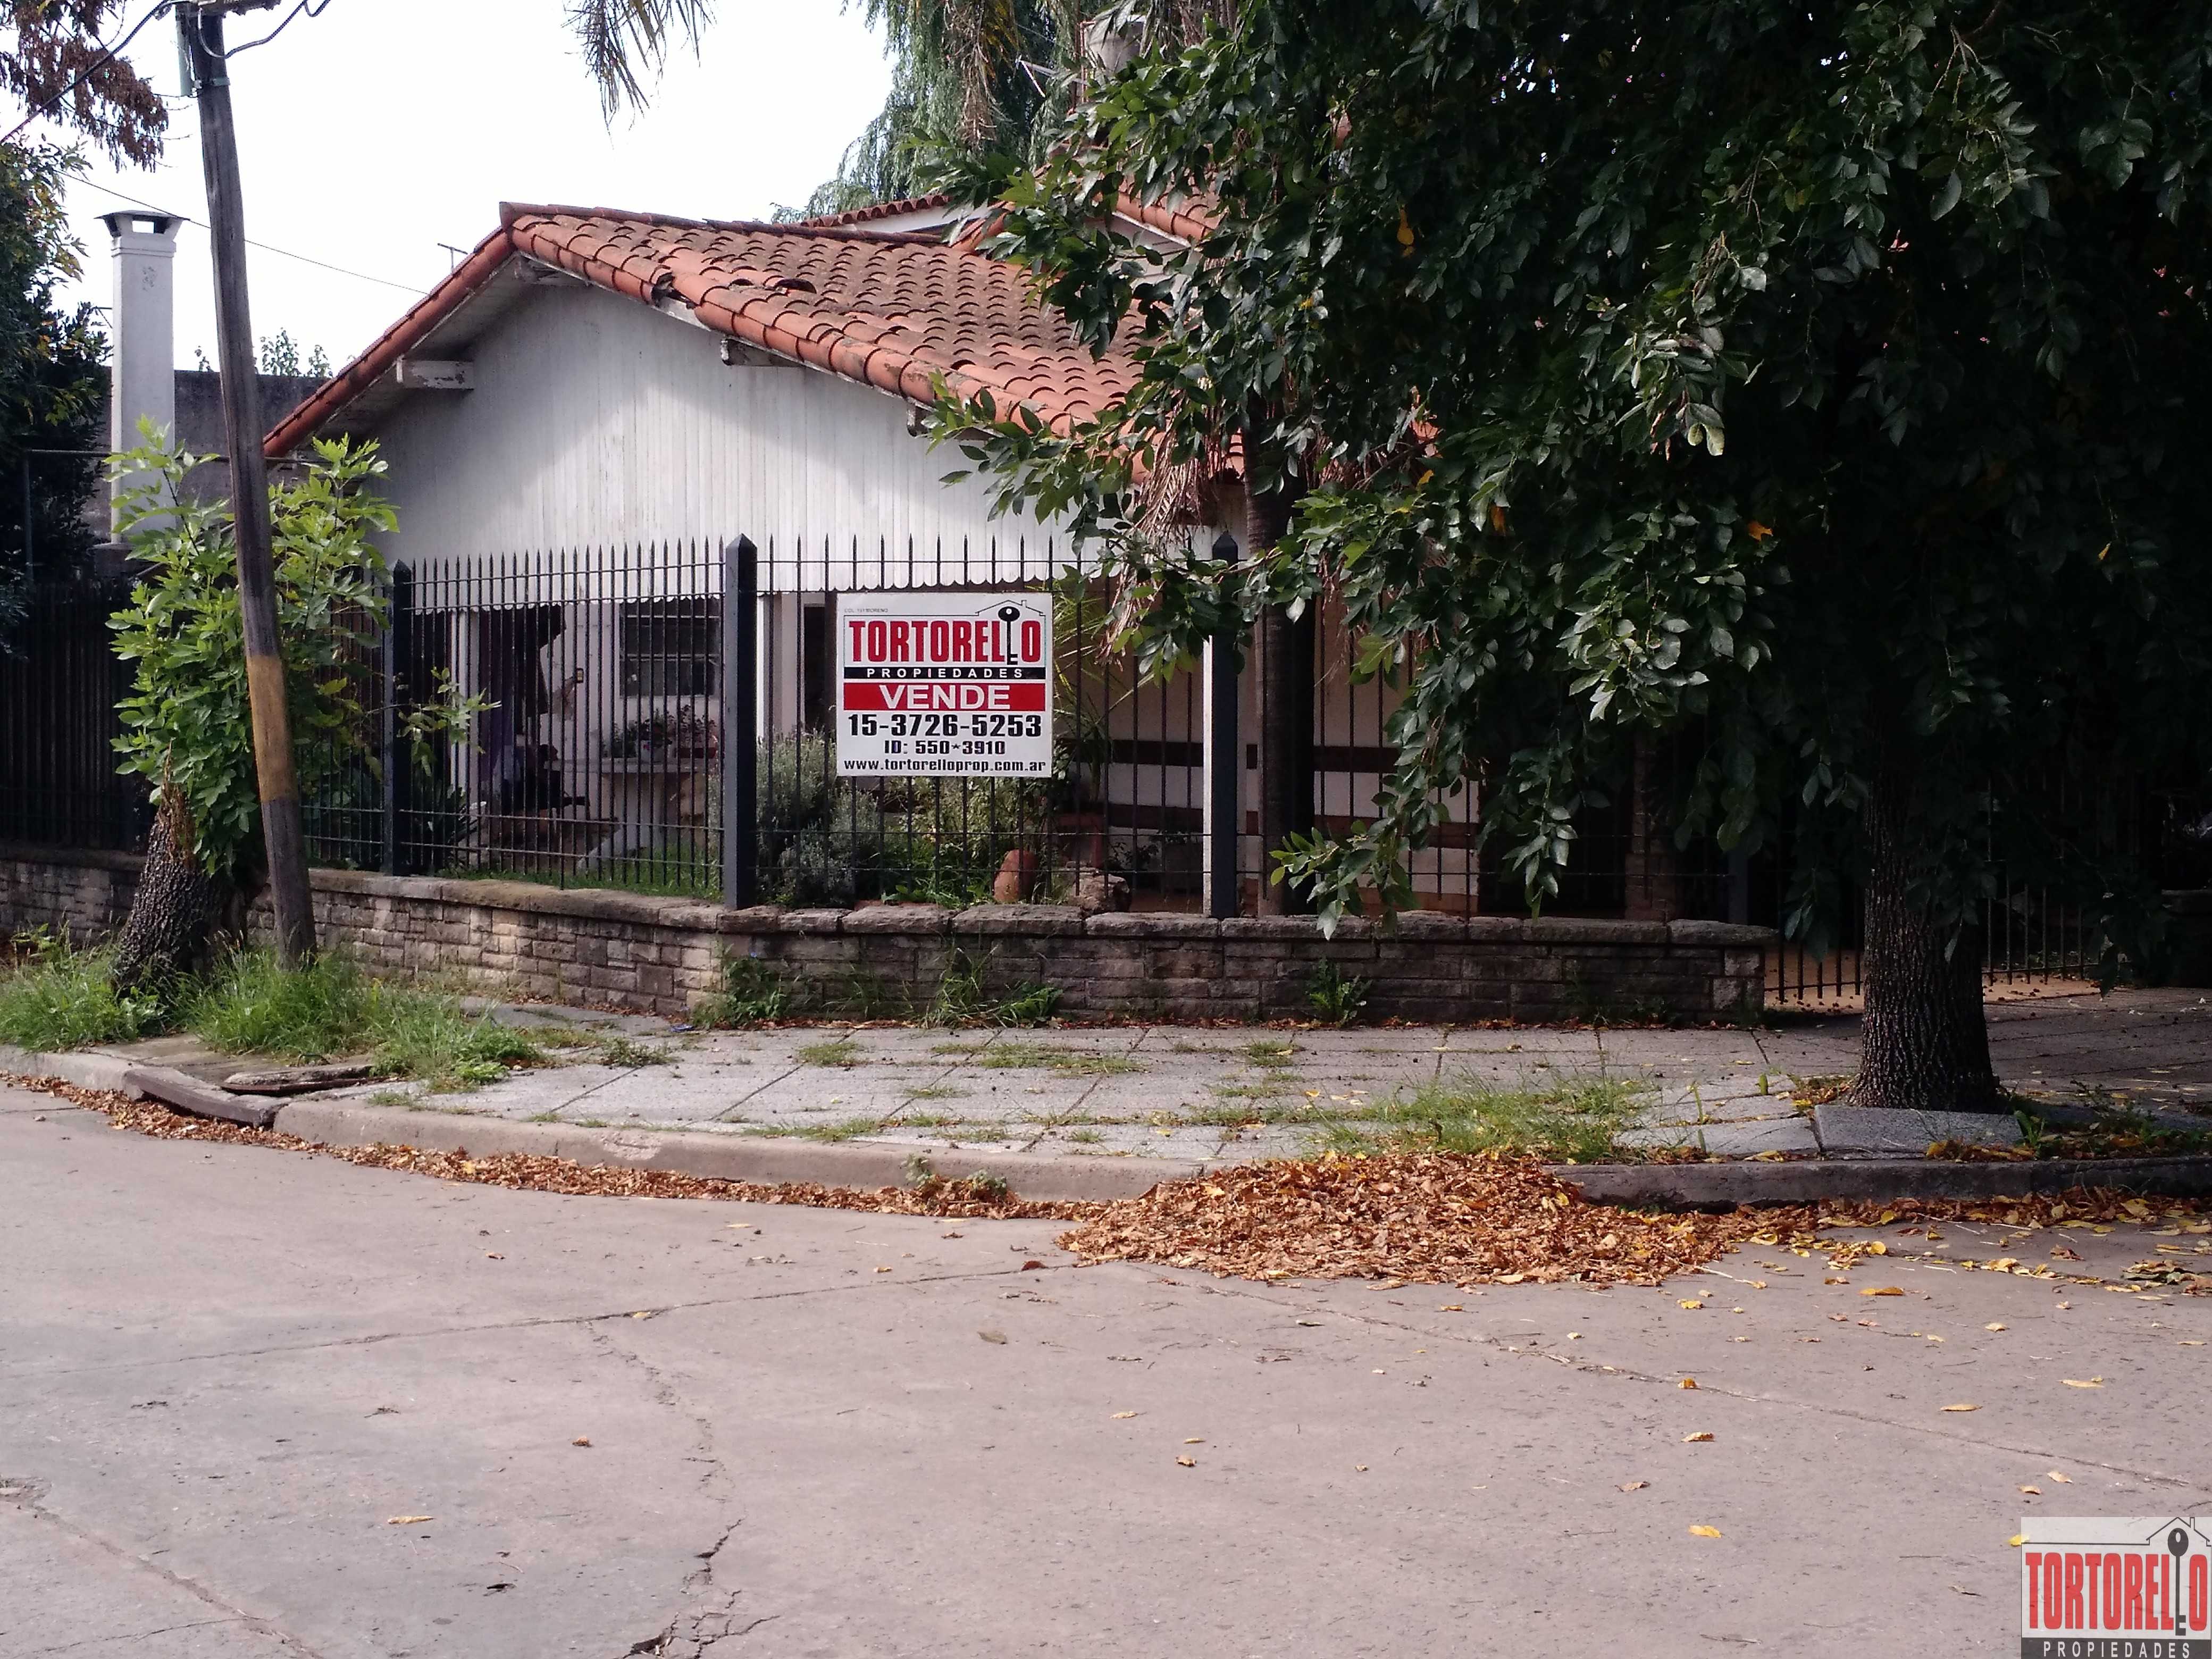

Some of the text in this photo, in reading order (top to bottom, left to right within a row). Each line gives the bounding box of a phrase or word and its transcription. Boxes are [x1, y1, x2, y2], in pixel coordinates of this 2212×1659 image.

[849, 621, 1041, 665] TORTORELLO
[867, 668, 1022, 677] PROPIEDADES
[879, 685, 1010, 709] VENDE
[849, 714, 1041, 736] 15-3726-5253
[884, 740, 908, 754] ID:
[844, 759, 1046, 773] www.tortorelloprop.com.ar
